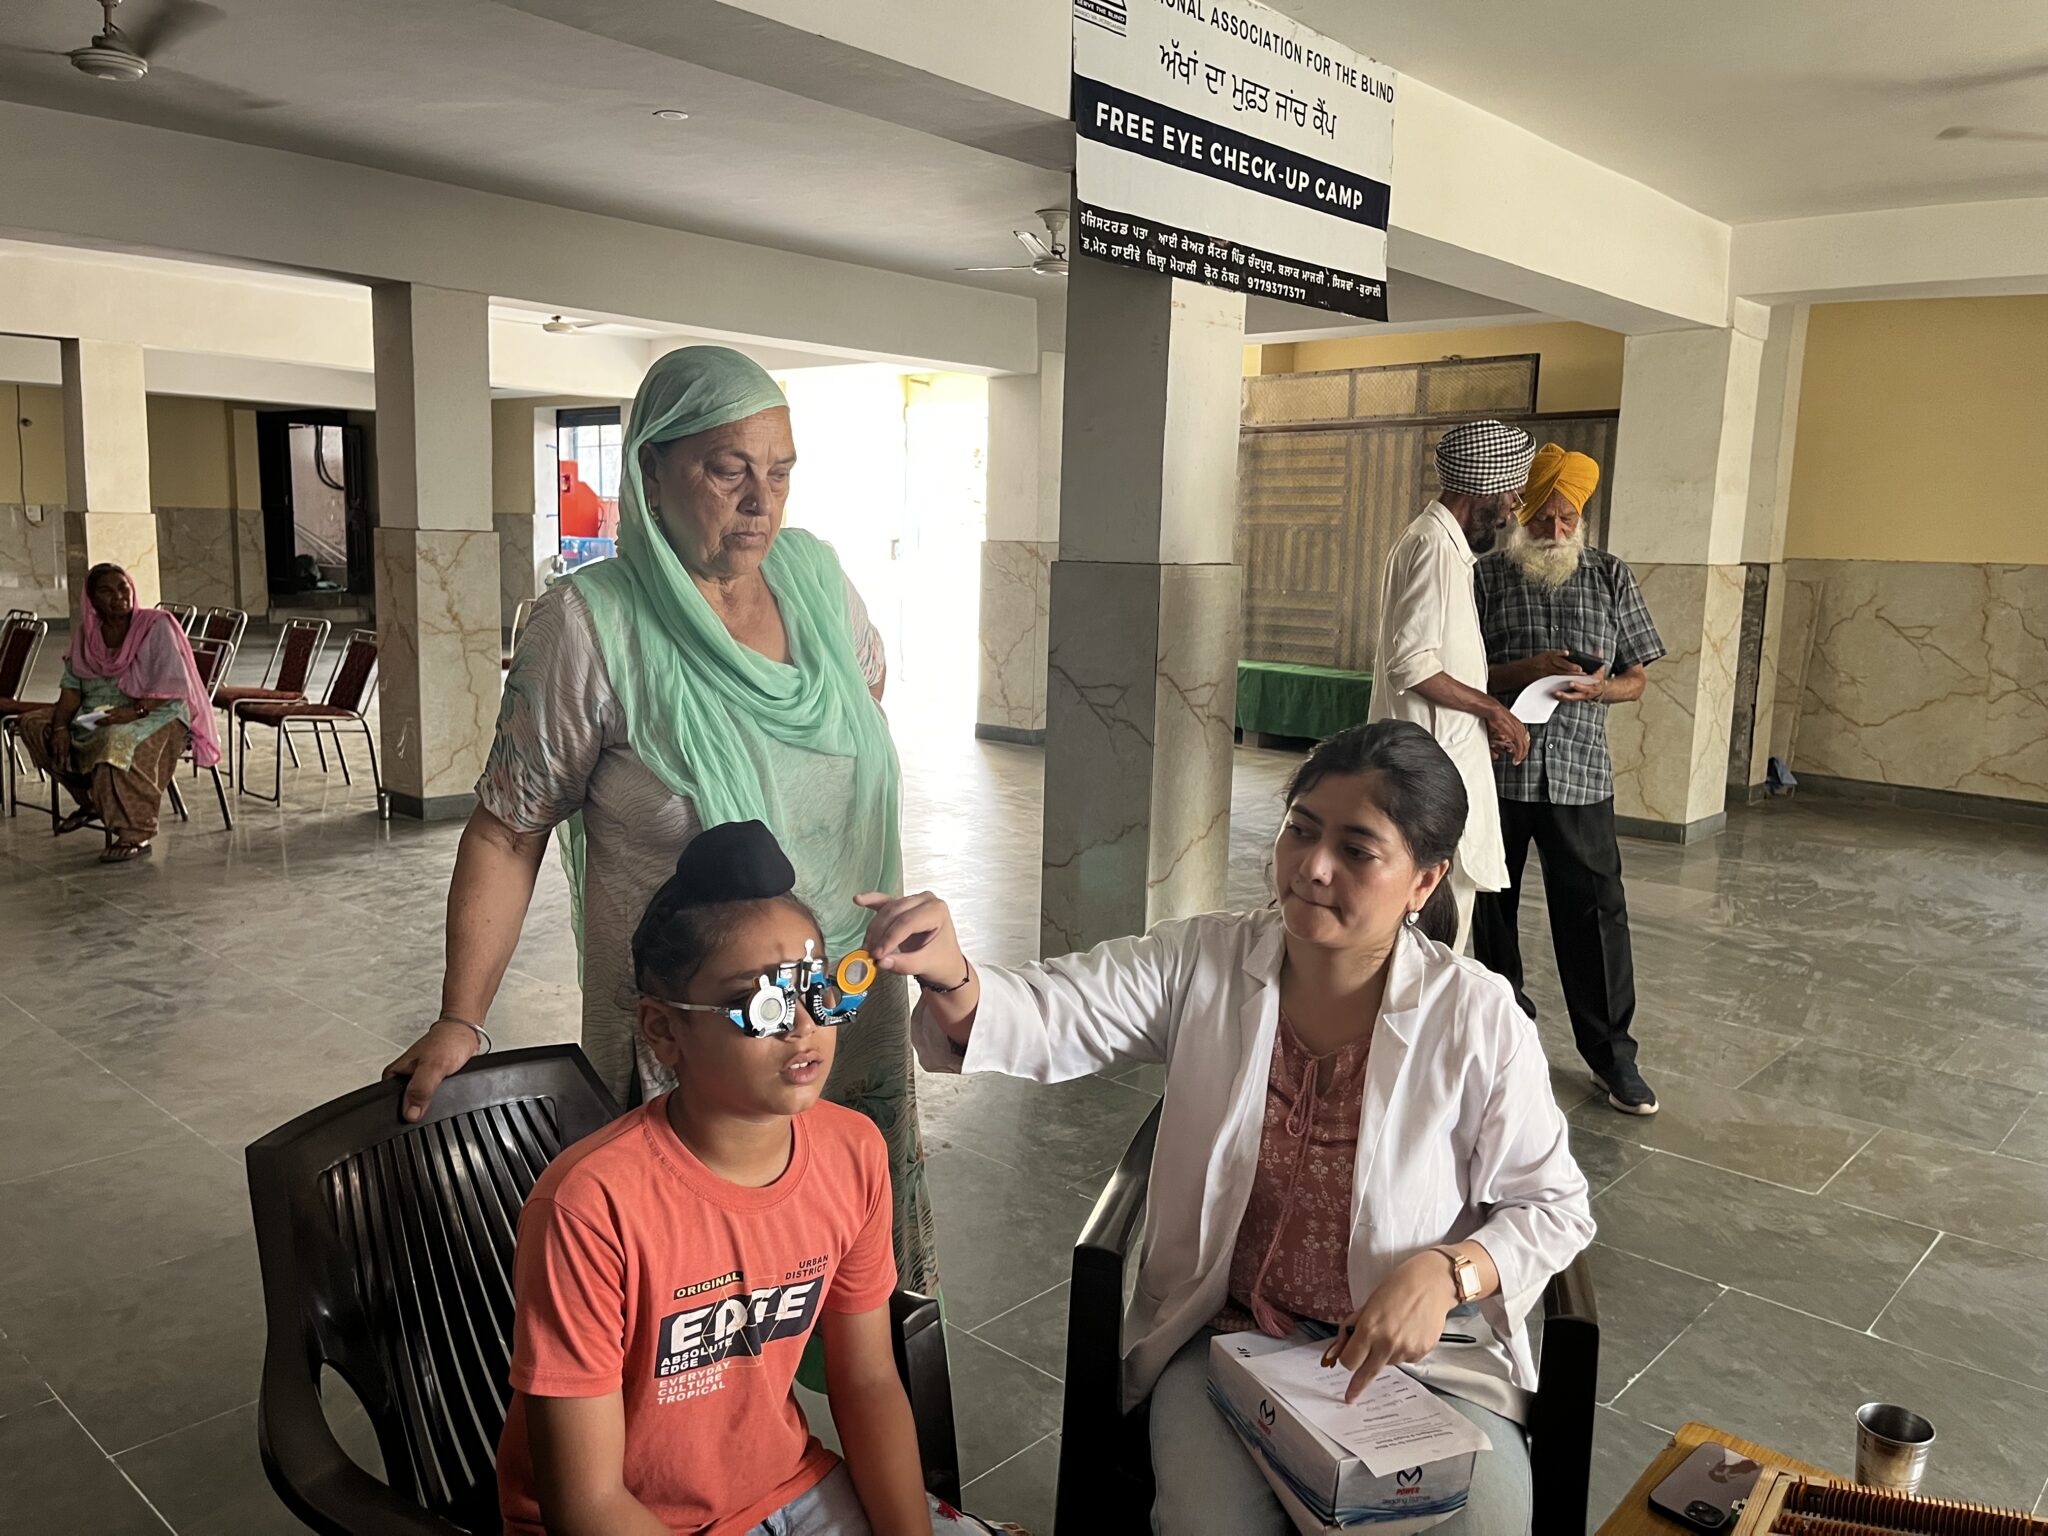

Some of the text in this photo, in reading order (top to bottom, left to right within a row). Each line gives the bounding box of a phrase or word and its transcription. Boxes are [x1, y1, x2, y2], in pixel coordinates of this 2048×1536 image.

[1107, 10, 1126, 23] BLIND
[1210, 7, 1302, 65] ASSOCIATION
[1306, 49, 1331, 77] FOR
[1335, 62, 1357, 89] THE
[1361, 74, 1394, 103] BLIND
[1159, 38, 1199, 85] ਅੱਖਾਂ
[1204, 63, 1227, 95] ਦਾ
[1275, 89, 1308, 128] ਜਾਂਚ
[1312, 97, 1338, 140] ਕੈਂਪ
[1096, 101, 1364, 211] FREE EYE CHECK-UP CAMP
[1080, 210, 1129, 235] ਰਜਿਸਟਰਡ
[1132, 225, 1149, 240] ਪਤਾ
[1158, 233, 1178, 249] ਆਈ
[1278, 264, 1301, 280] ਬਲਾਕ
[1221, 266, 1240, 285] ਨੰਬਰ
[1247, 276, 1306, 300] 9779377377
[785, 1263, 828, 1281] DISTRICT
[799, 1254, 829, 1269] URBAN
[676, 1271, 740, 1299] ORIGINAL
[660, 1336, 733, 1367] ABSOLUTE
[658, 1361, 731, 1388] EVERYDAY
[660, 1358, 699, 1376] EDGE
[656, 1381, 726, 1406] TROPICAL
[657, 1373, 722, 1397] CULTURE
